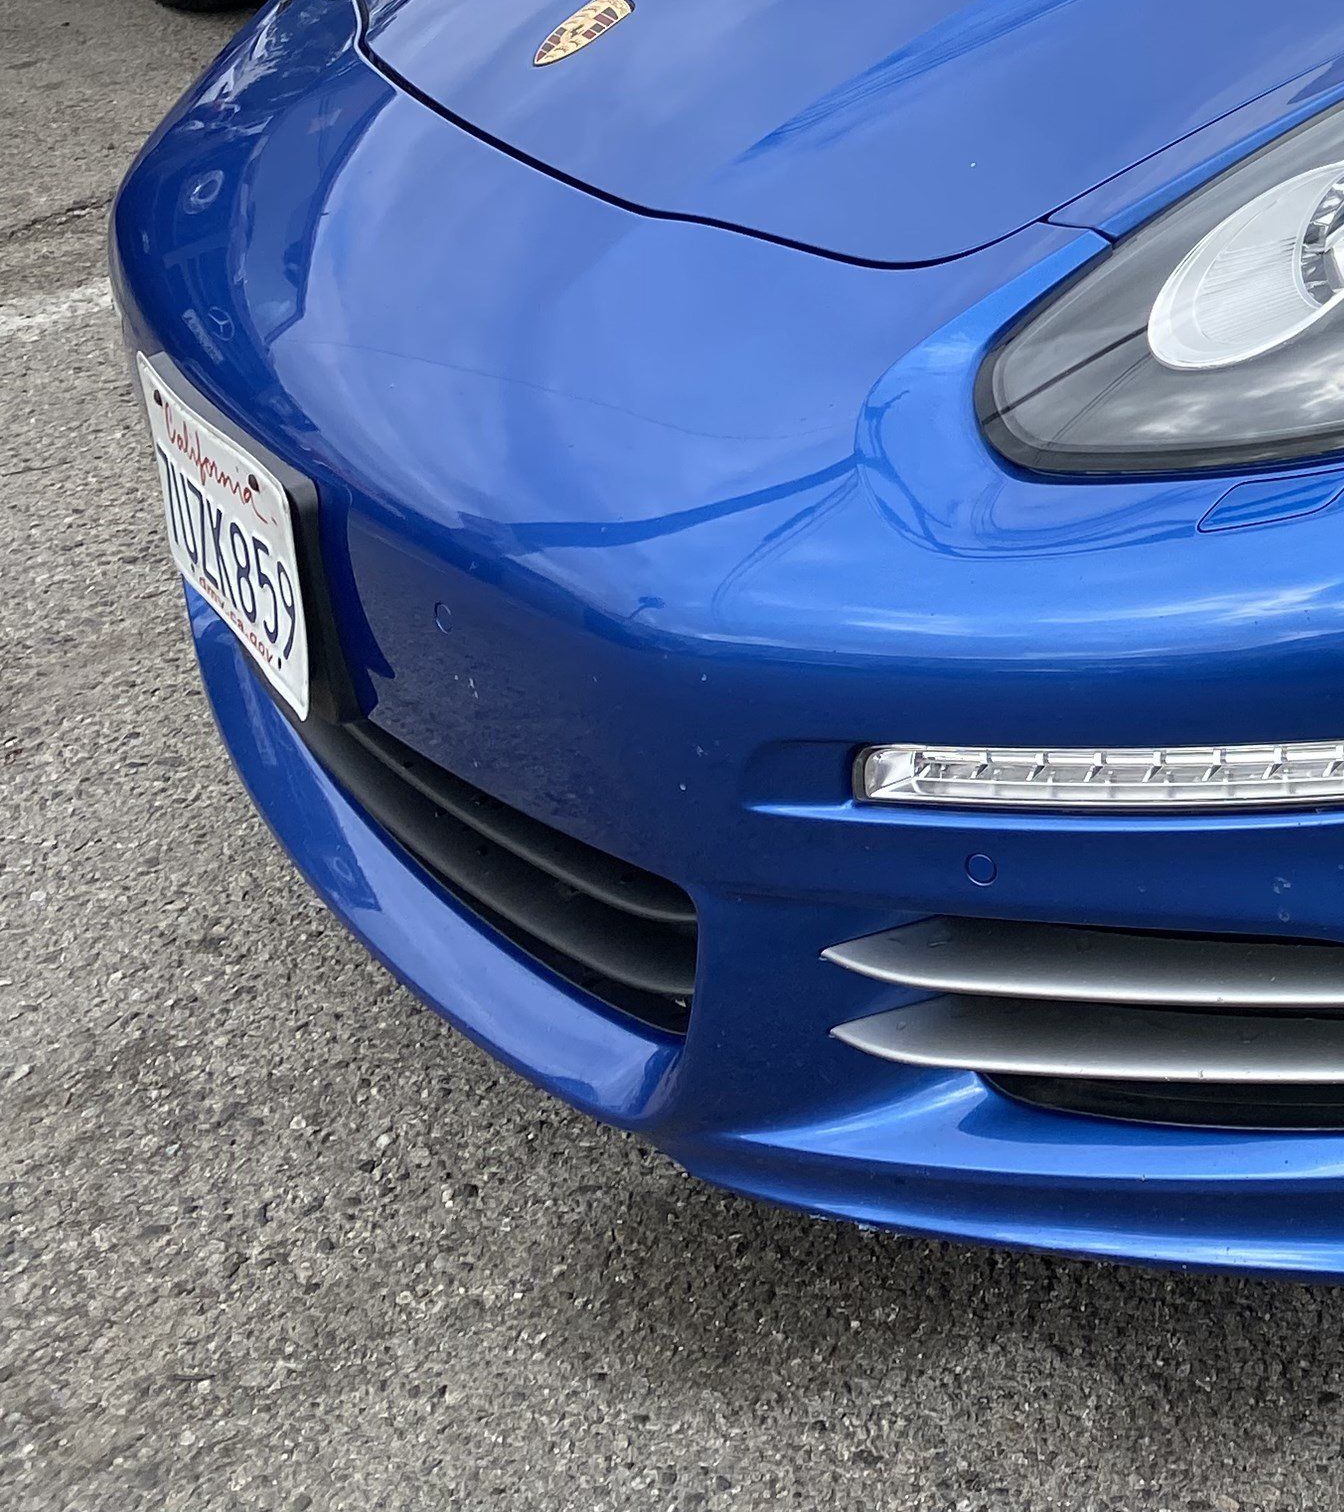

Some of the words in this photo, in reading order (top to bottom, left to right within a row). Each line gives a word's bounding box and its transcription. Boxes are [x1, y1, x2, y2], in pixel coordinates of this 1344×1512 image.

[163, 402, 268, 525] California
[157, 442, 296, 660] 7UZK859
[199, 576, 274, 665] dmv.ca.gov
